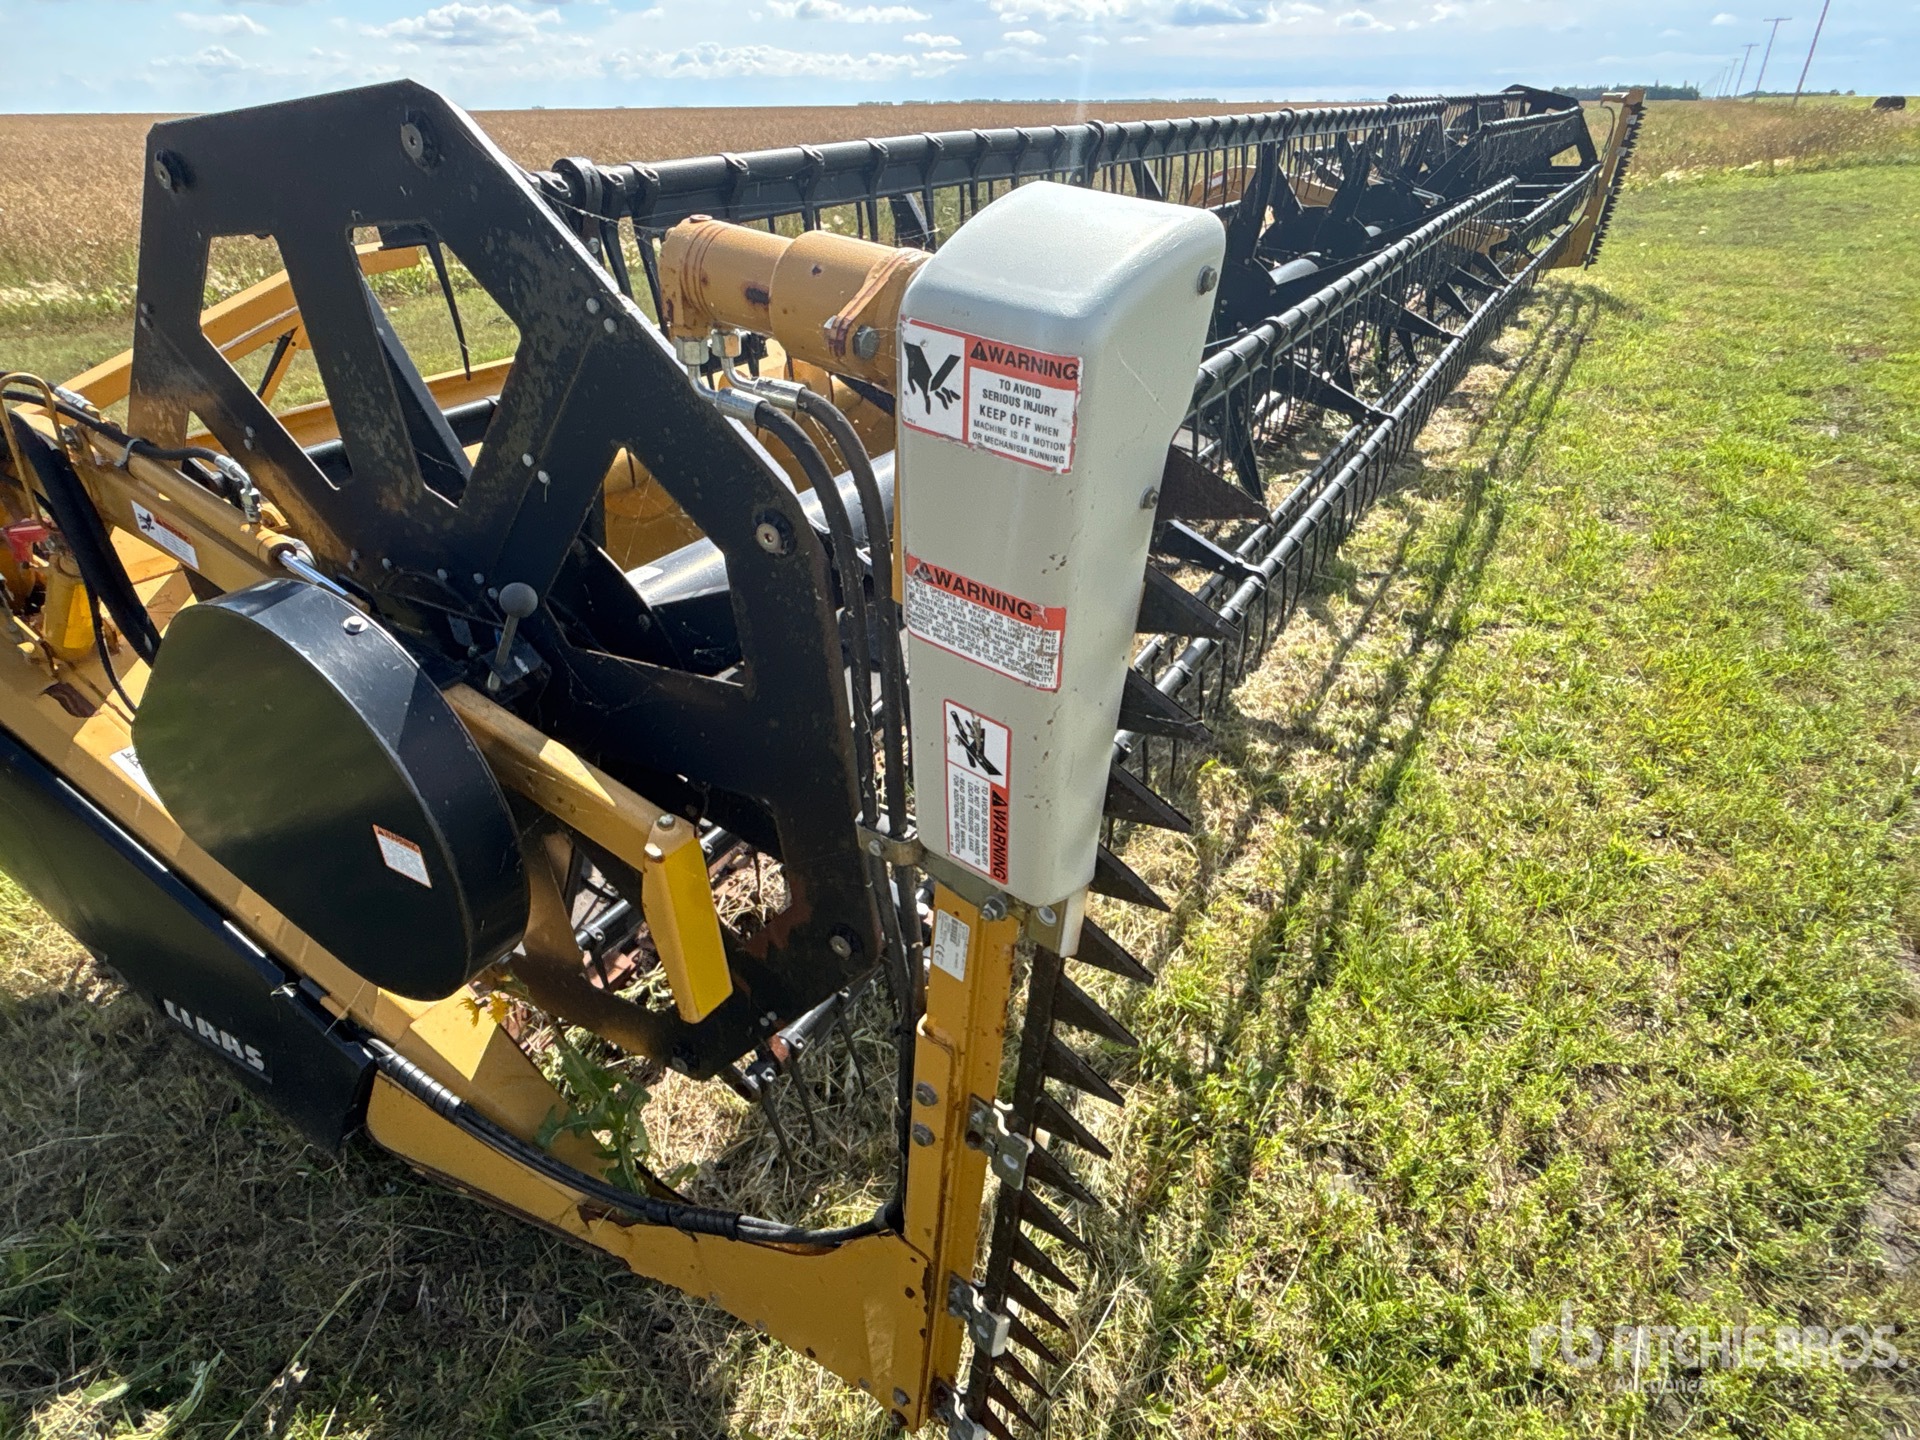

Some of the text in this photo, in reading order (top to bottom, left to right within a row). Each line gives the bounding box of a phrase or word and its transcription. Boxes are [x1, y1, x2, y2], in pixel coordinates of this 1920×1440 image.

[988, 345, 1079, 381] WARNING
[983, 389, 1057, 417] SERIOUS INJURY
[999, 379, 1041, 399] TO AVOID
[974, 420, 1066, 451] MACHINE IS IN MOTION
[979, 405, 1059, 437] KEEP OFF WHEN
[972, 432, 1064, 463] OR MECHANISM RUNNING
[935, 568, 1032, 621] WARNING
[982, 786, 988, 794] TO
[992, 809, 1007, 880] WARNING
